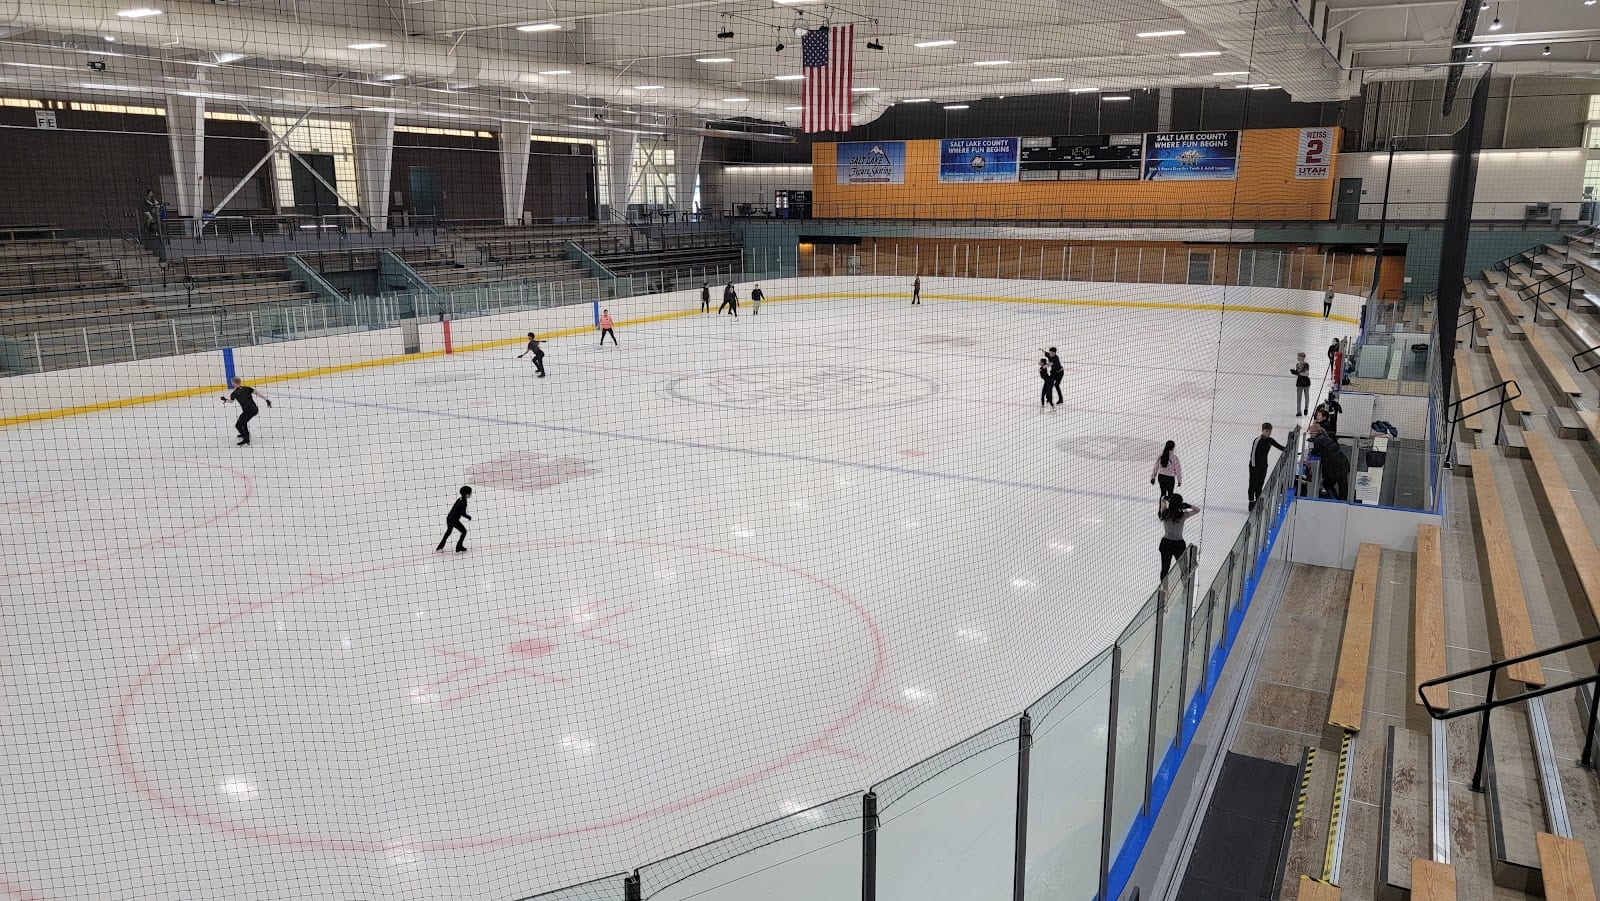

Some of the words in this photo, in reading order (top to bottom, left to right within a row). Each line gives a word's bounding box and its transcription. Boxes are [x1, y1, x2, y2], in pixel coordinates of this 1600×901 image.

[1072, 147, 1089, 156] 12:40
[1306, 140, 1323, 163] 2
[850, 156, 866, 164] SALT
[866, 156, 883, 164] LAKE
